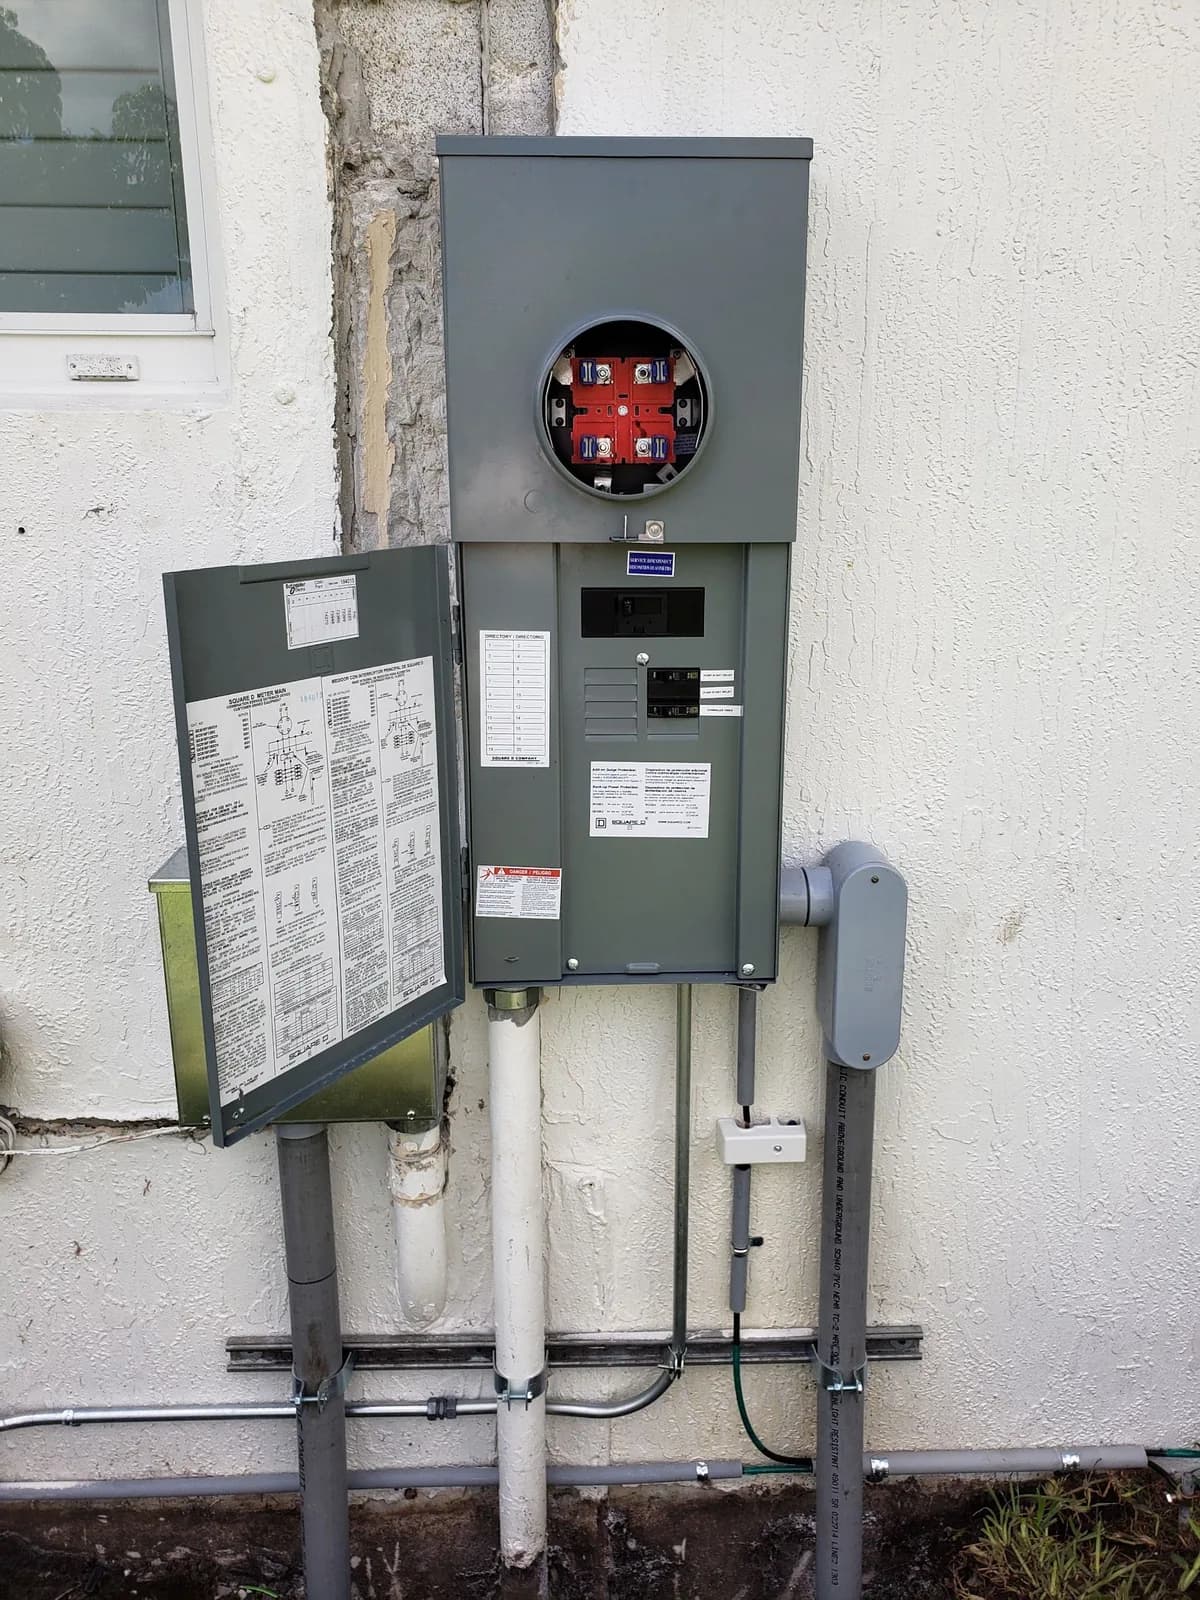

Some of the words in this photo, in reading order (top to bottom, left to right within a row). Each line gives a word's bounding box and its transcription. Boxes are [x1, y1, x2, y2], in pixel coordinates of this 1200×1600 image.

[228, 695, 250, 704] SQUARE
[257, 689, 274, 699] METER
[402, 979, 429, 998] SQUARE
[288, 1038, 321, 1061] SQUARE
[322, 1033, 329, 1042] D
[838, 1084, 847, 1119] CONDUIT
[836, 1121, 846, 1174] ABOVEGROUND
[835, 1176, 844, 1191] AND
[833, 1193, 845, 1245] UNDERGROUND
[832, 1248, 842, 1271] SCH40
[831, 1313, 841, 1332] TC-2
[831, 1392, 840, 1426] UNLIGHT
[831, 1428, 840, 1469] RESISTANT
